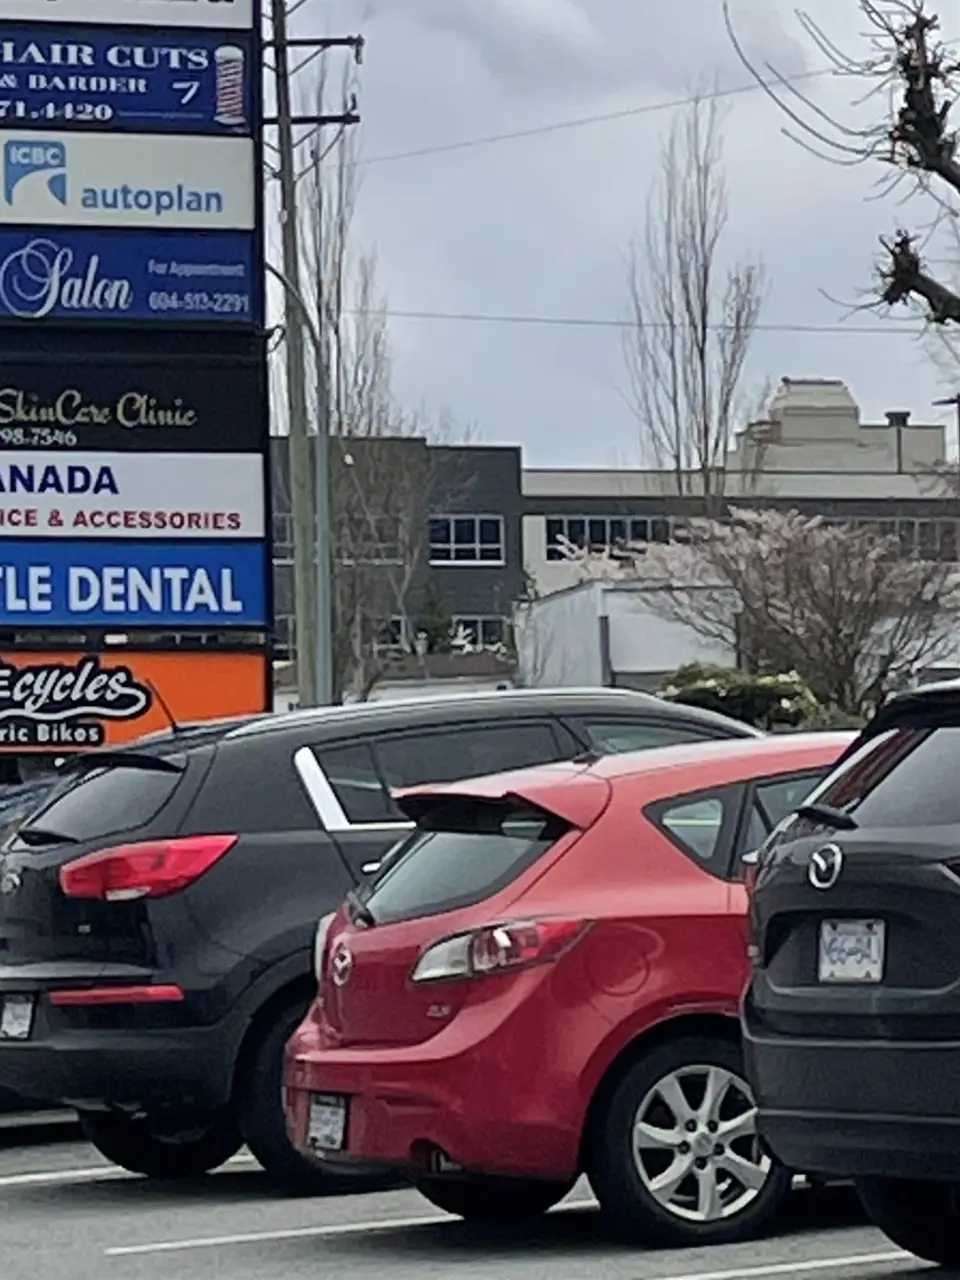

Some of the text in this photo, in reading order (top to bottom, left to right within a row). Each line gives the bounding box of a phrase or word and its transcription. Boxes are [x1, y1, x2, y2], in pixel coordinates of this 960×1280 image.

[106, 45, 209, 70] CUTS
[28, 73, 148, 94] BARBER
[9, 145, 63, 166] ICBC
[81, 184, 224, 217] autoplan
[116, 392, 198, 428] Clinic
[48, 510, 64, 527] &
[72, 510, 242, 530] ACCESSORIES
[68, 567, 243, 612] DENTAL
[37, 723, 100, 742] Bikes
